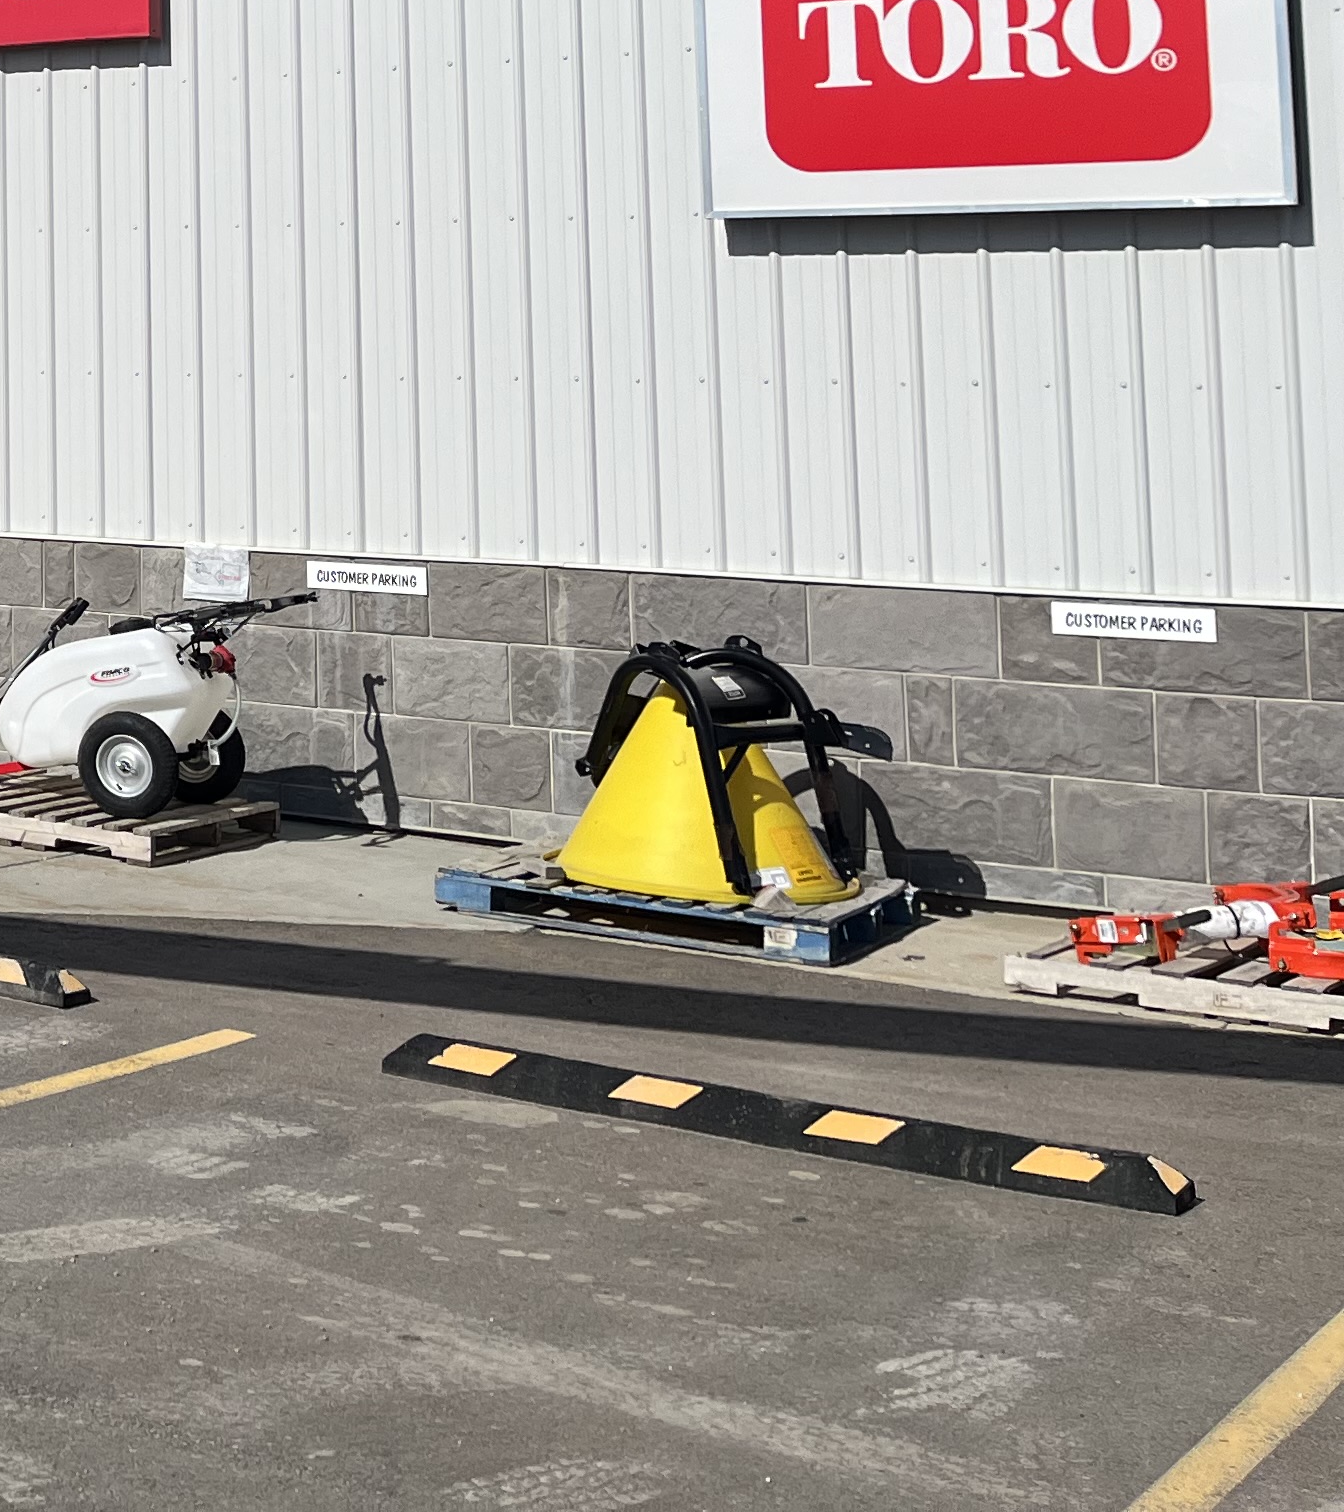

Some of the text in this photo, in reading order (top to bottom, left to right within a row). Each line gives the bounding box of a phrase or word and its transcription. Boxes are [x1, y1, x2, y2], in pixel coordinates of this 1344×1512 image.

[317, 569, 417, 588] CUSTOMER PARKING
[1065, 611, 1203, 634] CUSTOMER PARKING
